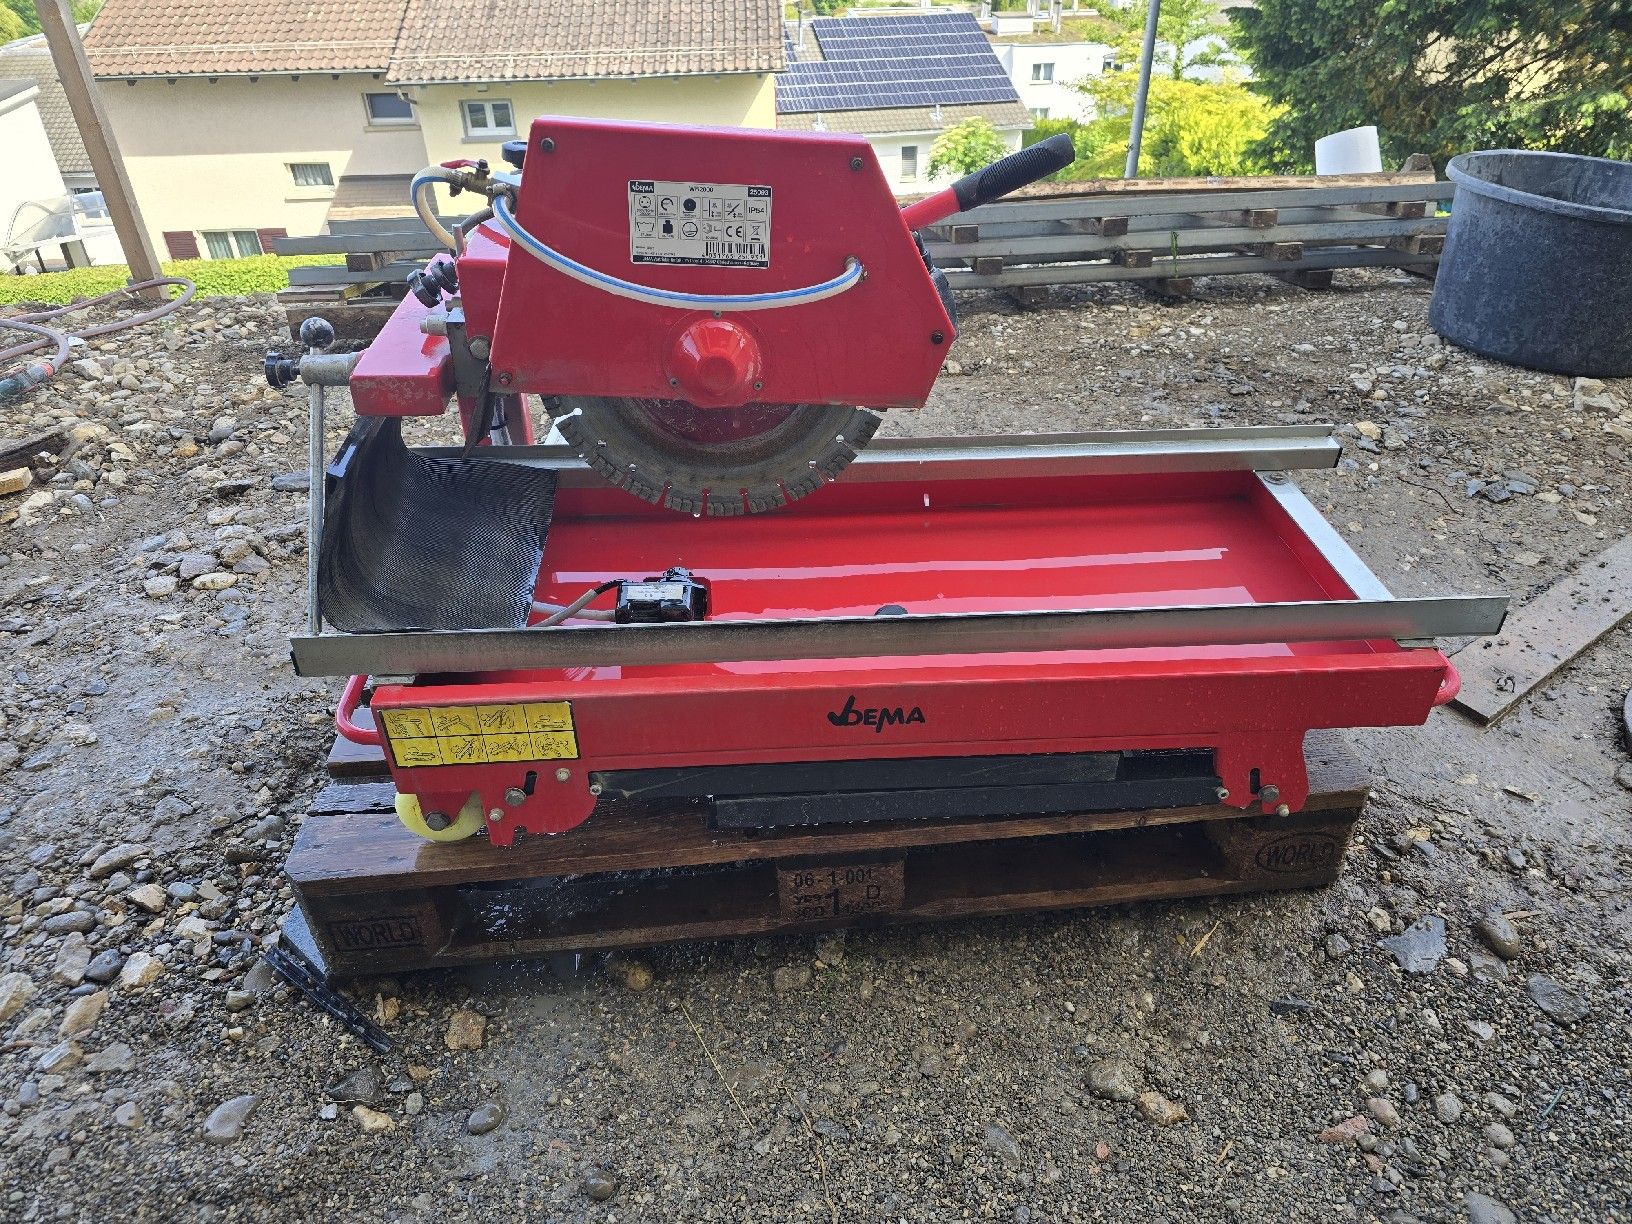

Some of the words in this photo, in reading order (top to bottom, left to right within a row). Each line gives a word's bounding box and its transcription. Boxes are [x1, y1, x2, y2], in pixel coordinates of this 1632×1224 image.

[749, 188, 769, 196] 25093
[748, 206, 765, 215] IP54
[725, 225, 743, 238] CE
[827, 694, 926, 734] DEMA
